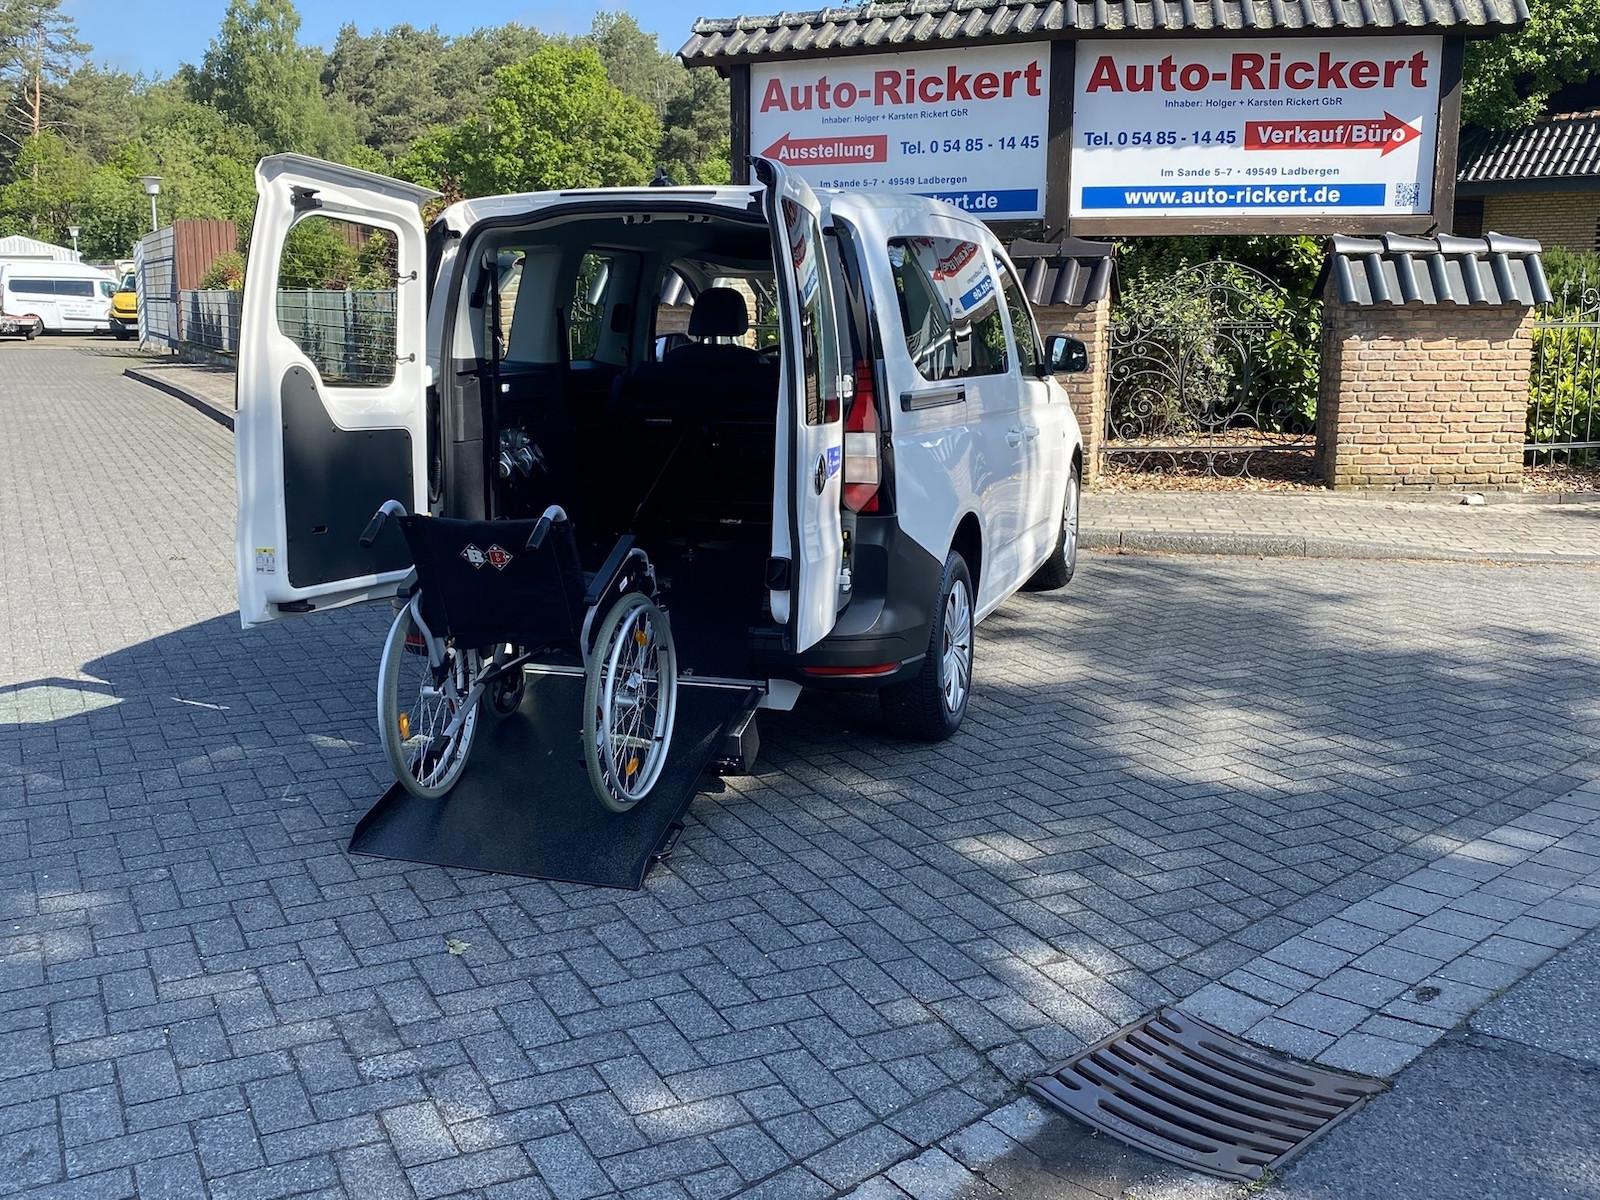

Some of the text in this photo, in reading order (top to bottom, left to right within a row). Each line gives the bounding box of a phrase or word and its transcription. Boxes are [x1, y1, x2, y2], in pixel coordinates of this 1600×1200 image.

[1085, 50, 1429, 93] Auto-Rickert
[760, 60, 1042, 113] Auto-Rickert
[1165, 99, 1203, 108] Inhaber:
[1206, 99, 1236, 109] Holger
[1247, 98, 1284, 107] Karsten
[1286, 97, 1320, 106] Rickert
[1322, 97, 1343, 106] GbR
[854, 114, 880, 124] Holger
[888, 112, 919, 121] Karsten
[920, 110, 949, 119] Rickert
[950, 108, 969, 117] GbR
[1084, 132, 1113, 146] Tel.
[1257, 124, 1406, 144] Verkauf/Büro
[778, 142, 875, 160] Ausstellung
[900, 141, 926, 155] Tel.
[1160, 168, 1174, 177] Im
[1177, 168, 1211, 177] Sande
[1245, 167, 1278, 176] 49549
[1281, 166, 1340, 178] Ladbergen
[820, 180, 831, 188] Im
[833, 179, 861, 188] Sande
[888, 177, 915, 186] 49549
[917, 175, 969, 186] Ladbergen
[1123, 187, 1341, 205] www.auto-rickert.de
